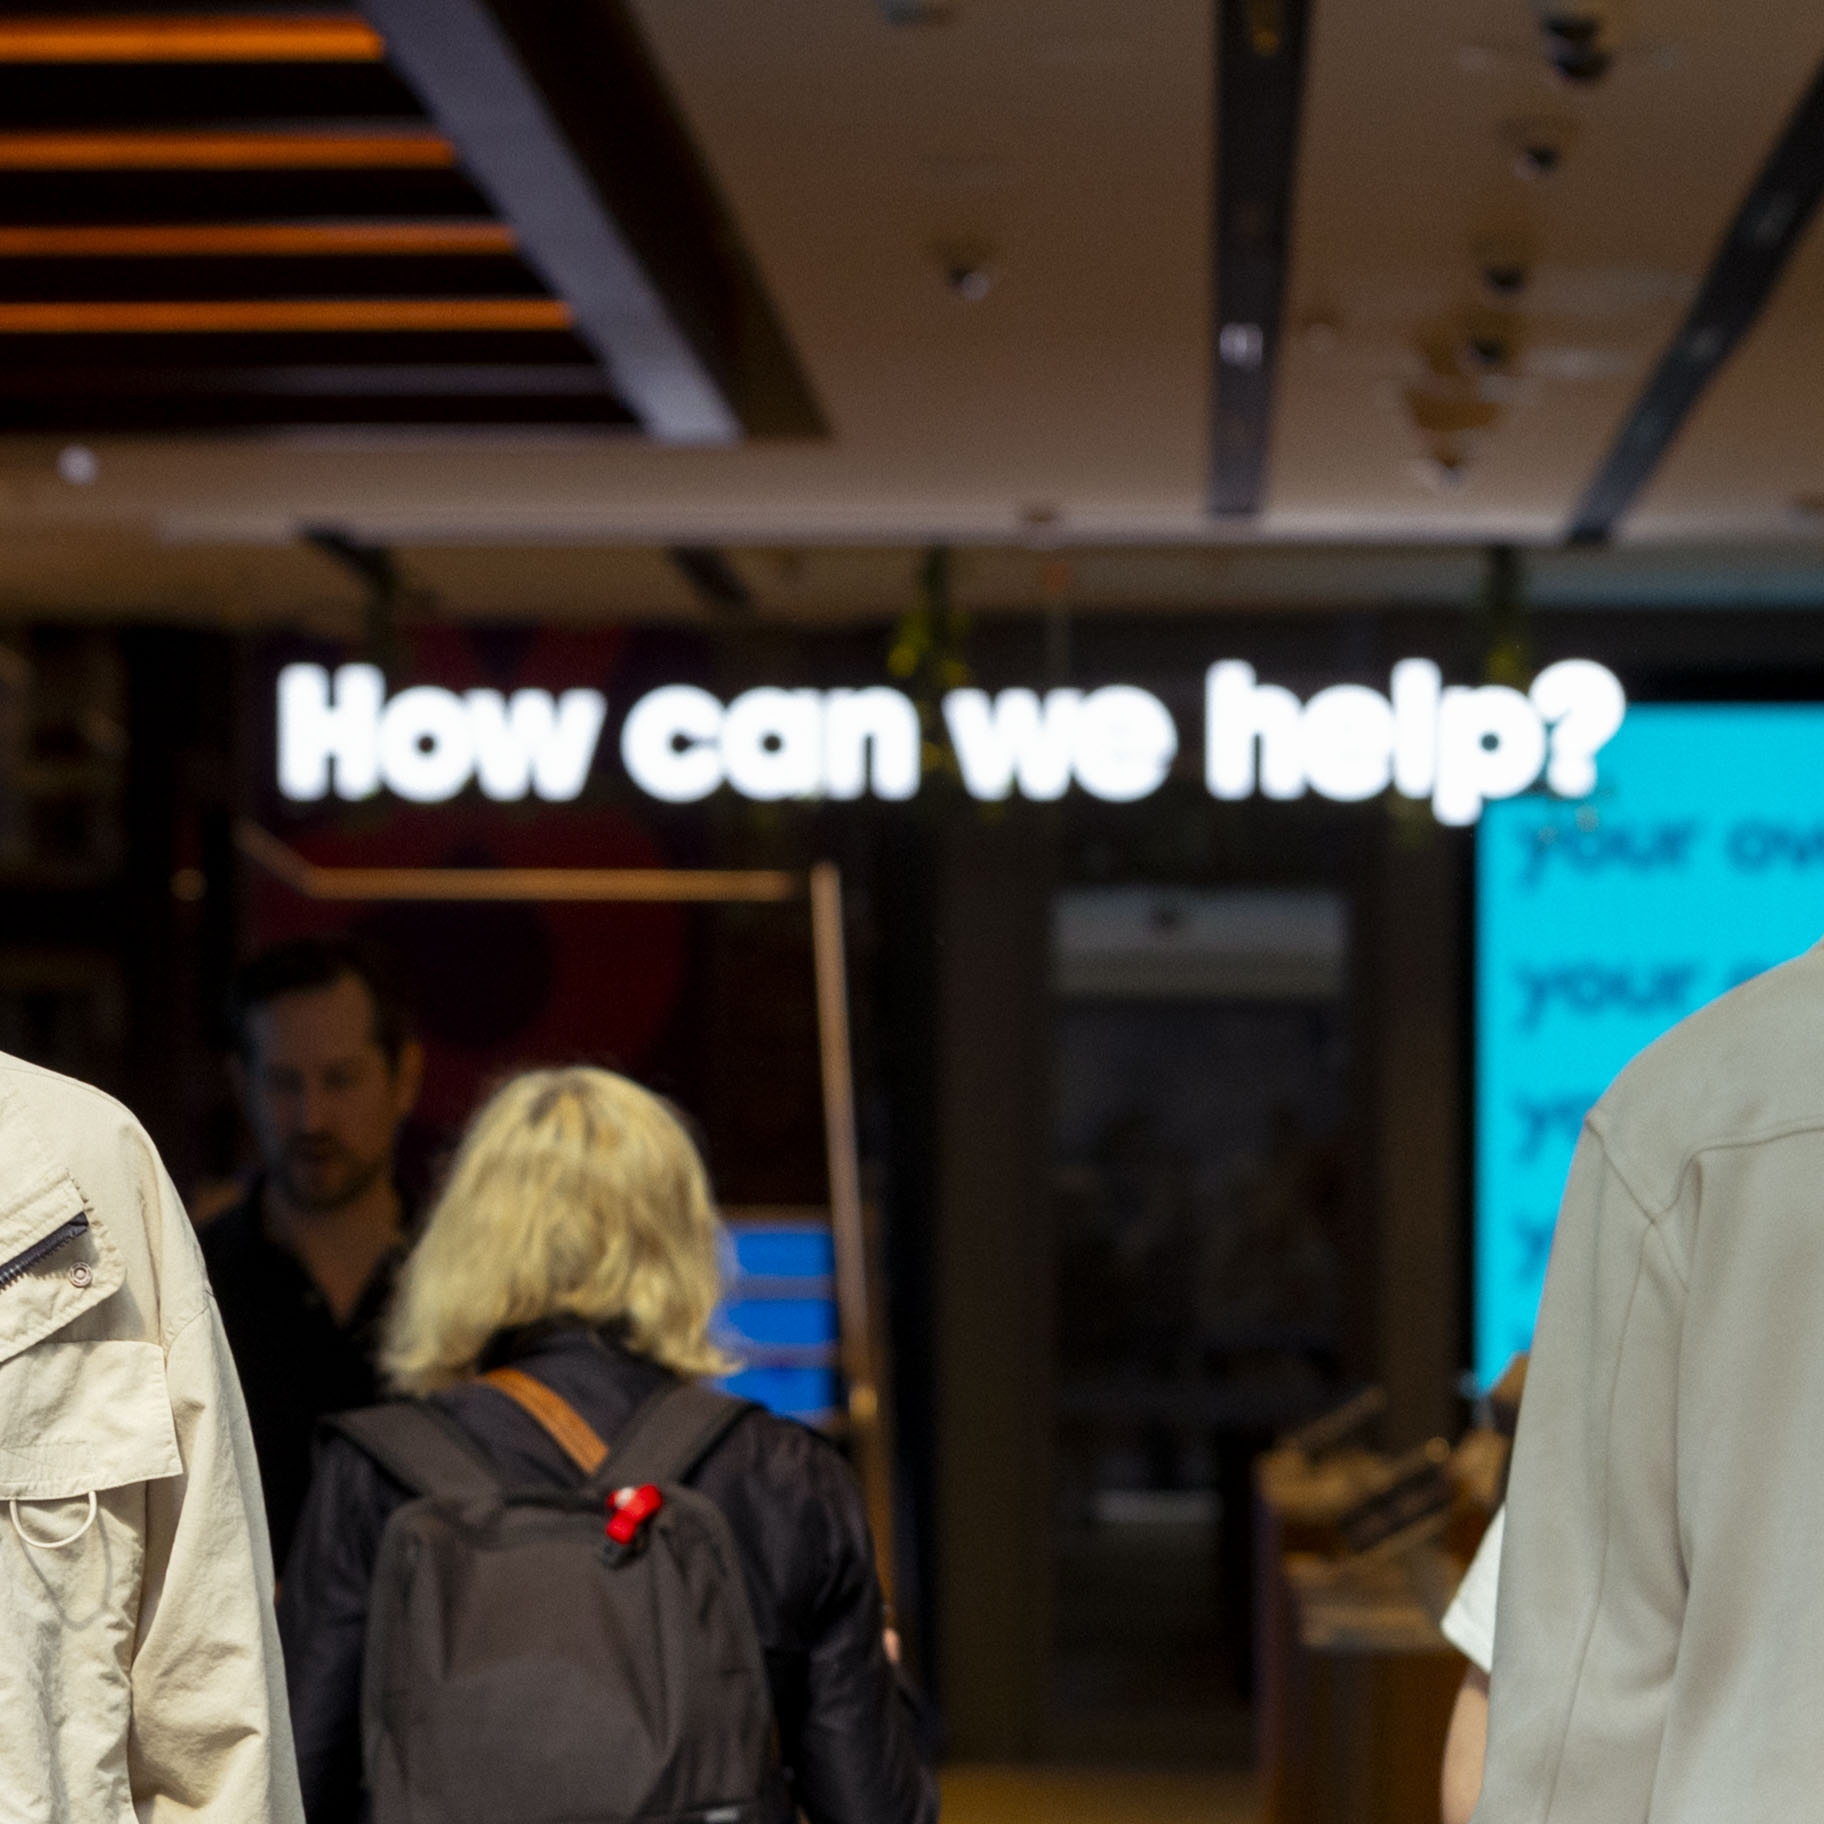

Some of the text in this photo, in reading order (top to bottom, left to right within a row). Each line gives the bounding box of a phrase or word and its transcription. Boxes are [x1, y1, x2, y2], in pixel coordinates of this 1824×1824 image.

[278, 659, 1627, 824] How can we help?
[1514, 818, 1701, 895] your
